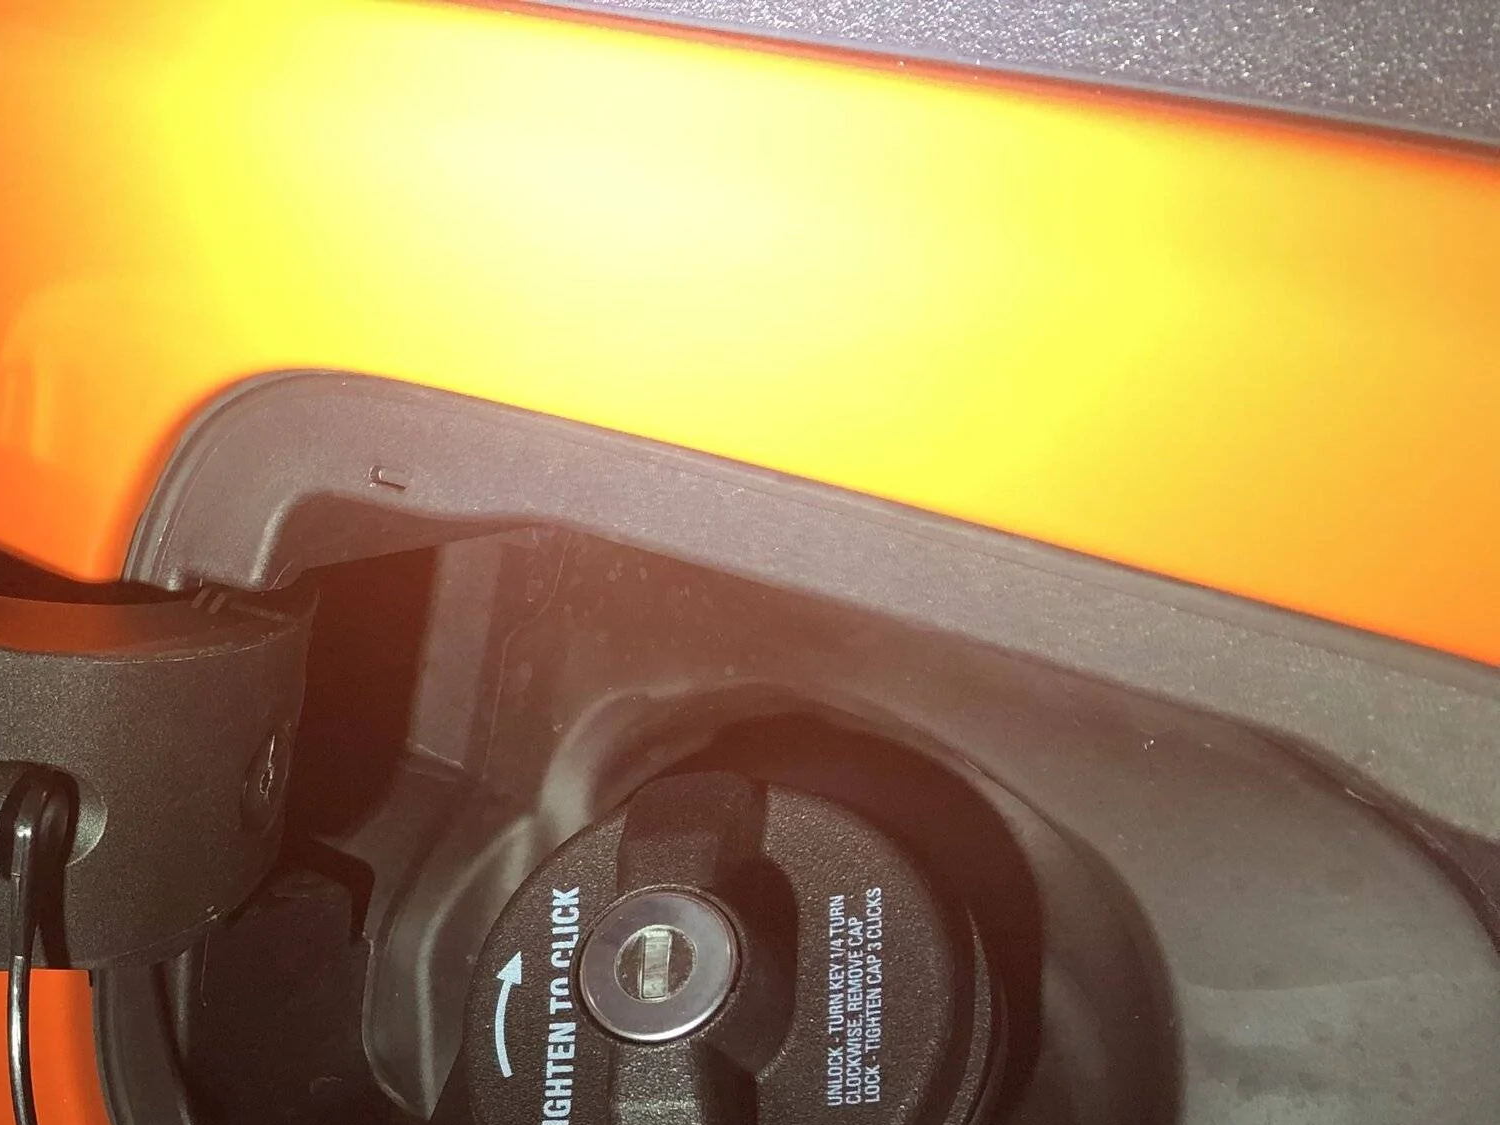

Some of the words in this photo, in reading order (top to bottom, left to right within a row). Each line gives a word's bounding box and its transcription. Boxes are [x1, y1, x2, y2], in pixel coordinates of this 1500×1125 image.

[552, 886, 581, 968] CLICK
[830, 895, 844, 936] TURN
[849, 916, 863, 946] CAP
[867, 887, 882, 939] CLICKS
[830, 938, 846, 959] 1/4
[868, 941, 882, 951] 3
[830, 963, 844, 990] KEY
[848, 950, 863, 1011] REMOVE
[867, 953, 882, 985] CAP
[550, 976, 574, 1015] TO
[829, 992, 844, 1034] TURN
[865, 988, 881, 1053] TIGHTEN
[828, 1046, 843, 1106] UNLOCK
[865, 1064, 880, 1103] LOCK
